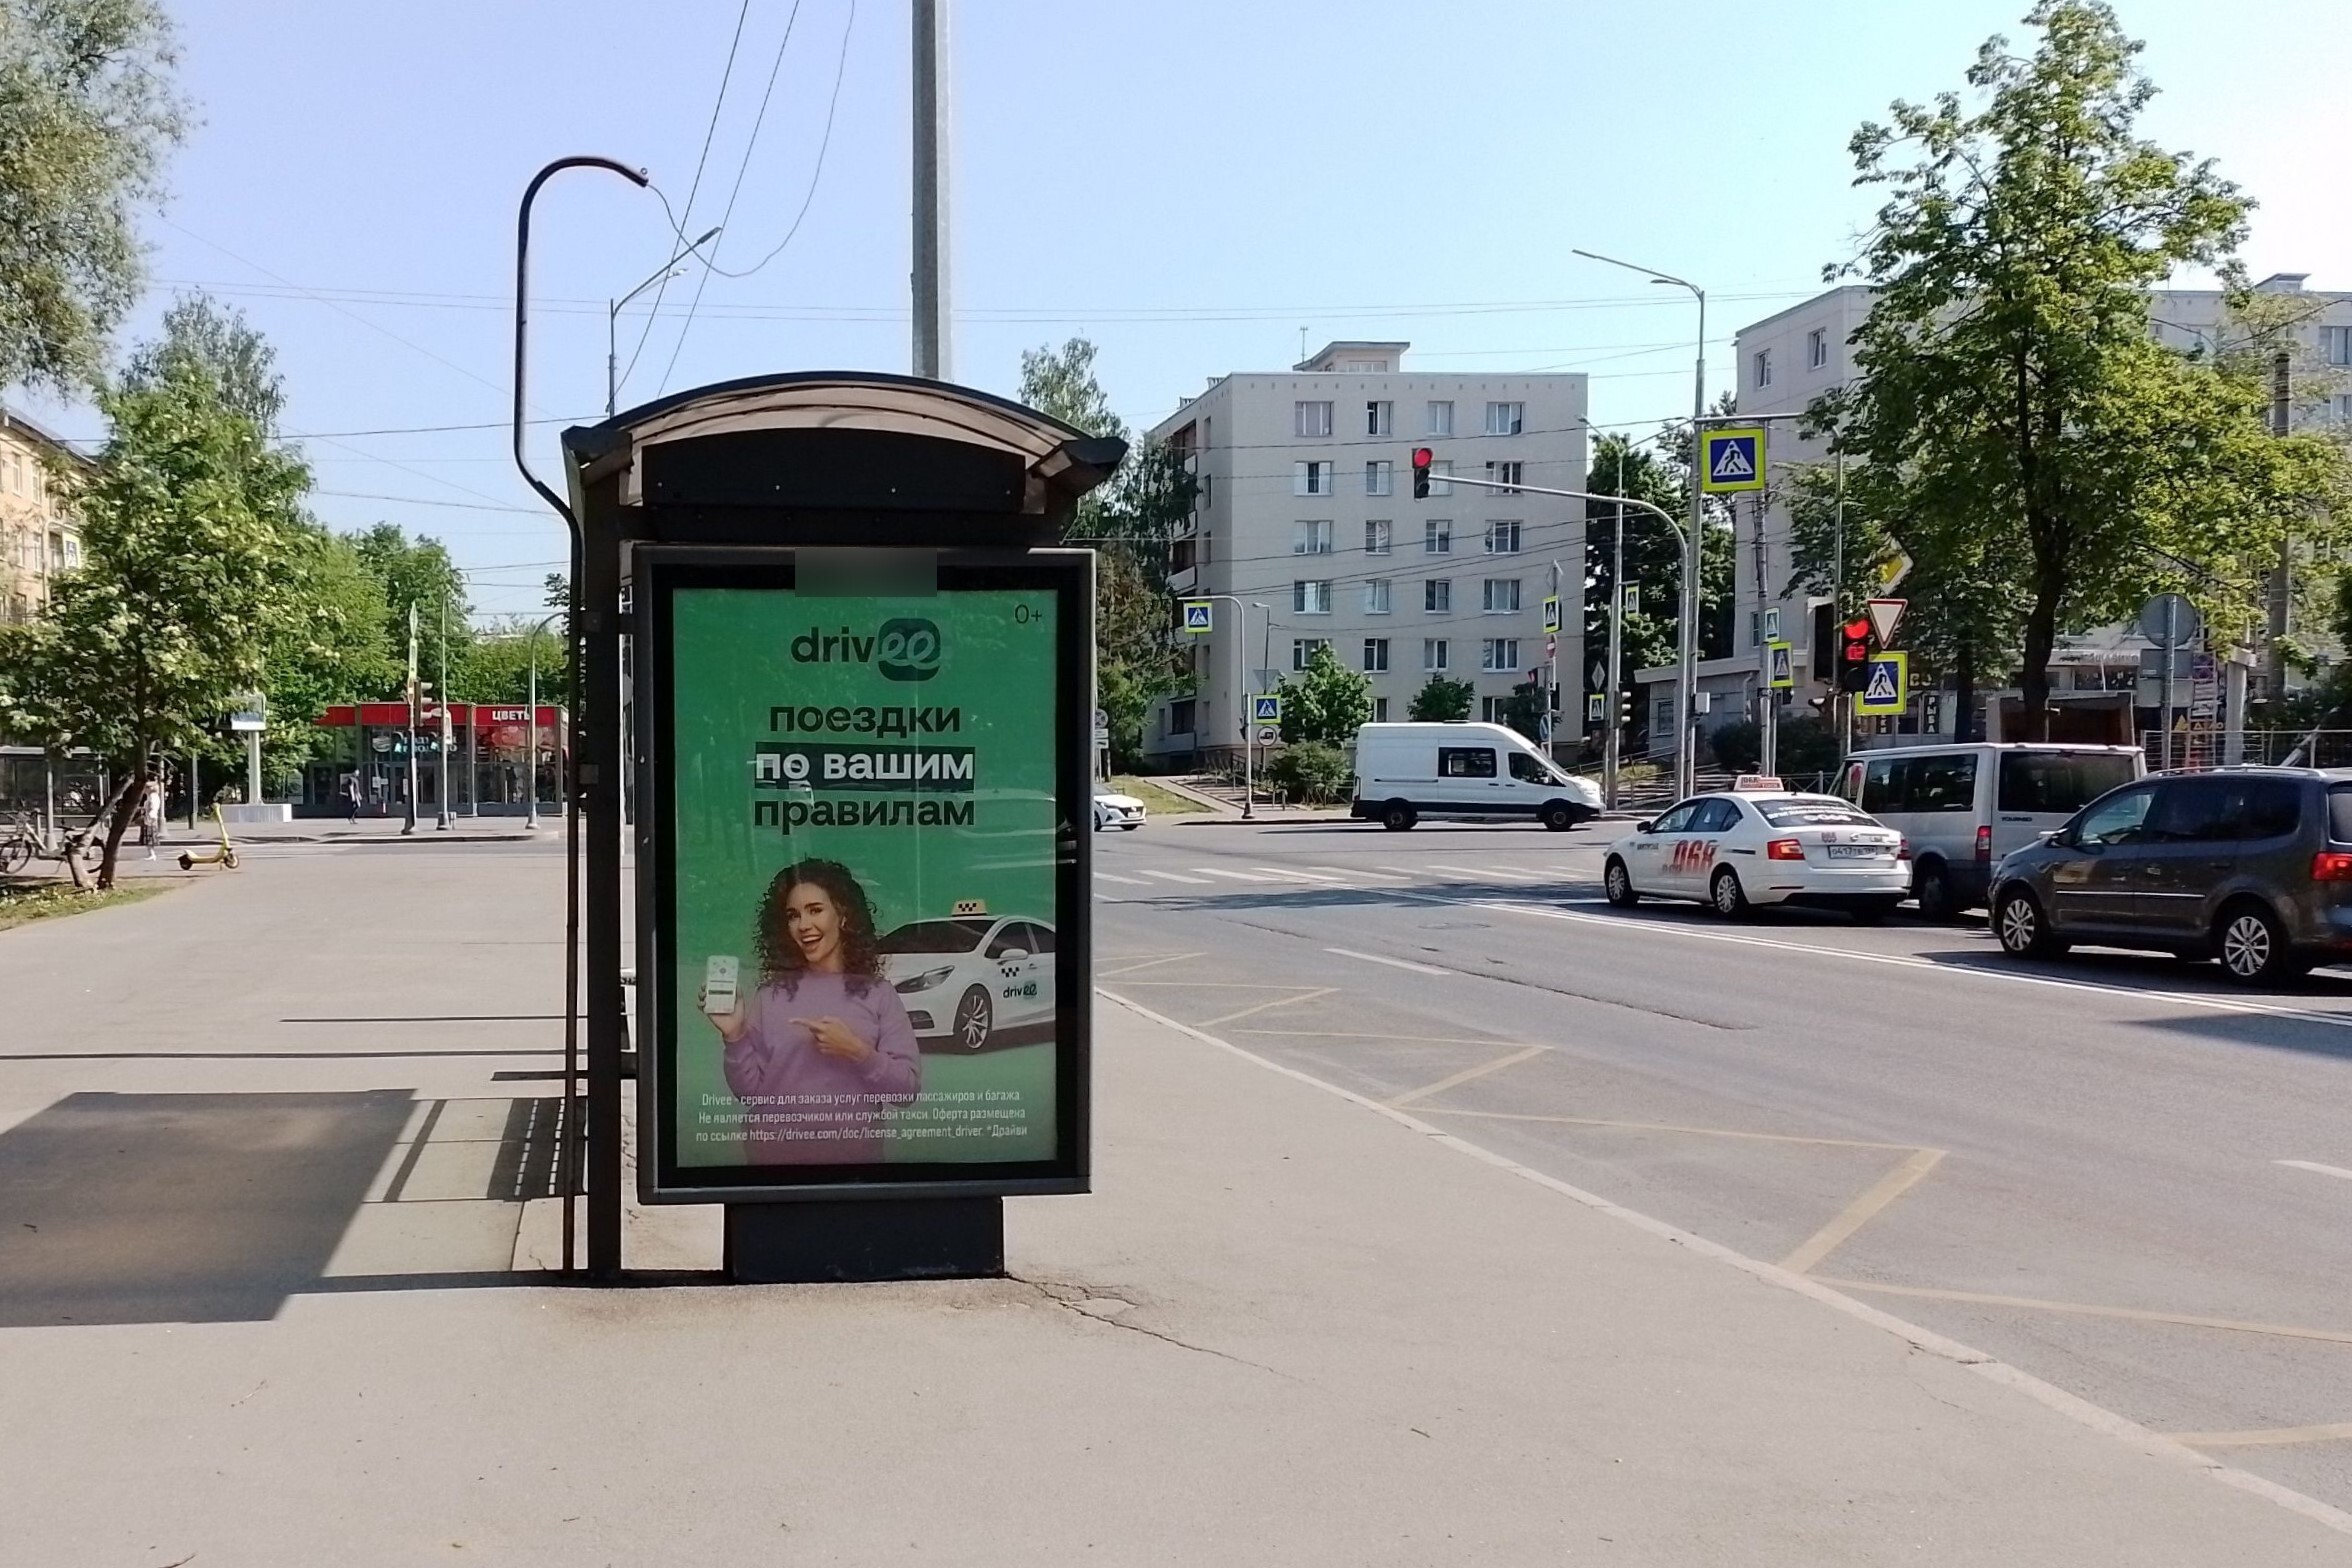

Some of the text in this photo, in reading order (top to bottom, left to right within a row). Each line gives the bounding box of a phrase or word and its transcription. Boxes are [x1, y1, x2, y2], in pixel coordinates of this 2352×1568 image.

[1013, 604, 1043, 625] 0+
[768, 706, 961, 739] поездки
[755, 752, 975, 781] по вашим
[754, 799, 976, 836] правилам
[702, 1093, 732, 1106] Drivee
[740, 1094, 776, 1107] сервис
[777, 1095, 797, 1106] для
[798, 1094, 832, 1105] заказа
[834, 1093, 862, 1106] услуг
[863, 1092, 914, 1105] перевозки
[916, 1090, 975, 1103] пассажиров
[698, 1112, 712, 1124] Не
[713, 1113, 761, 1124] является
[762, 1112, 833, 1125] перевозчиком
[835, 1111, 854, 1121] или
[855, 1109, 898, 1123] службой
[932, 1107, 969, 1122] Оферта
[970, 1107, 1026, 1121] размещена
[696, 1132, 709, 1142] по
[710, 1131, 749, 1142] ссылке
